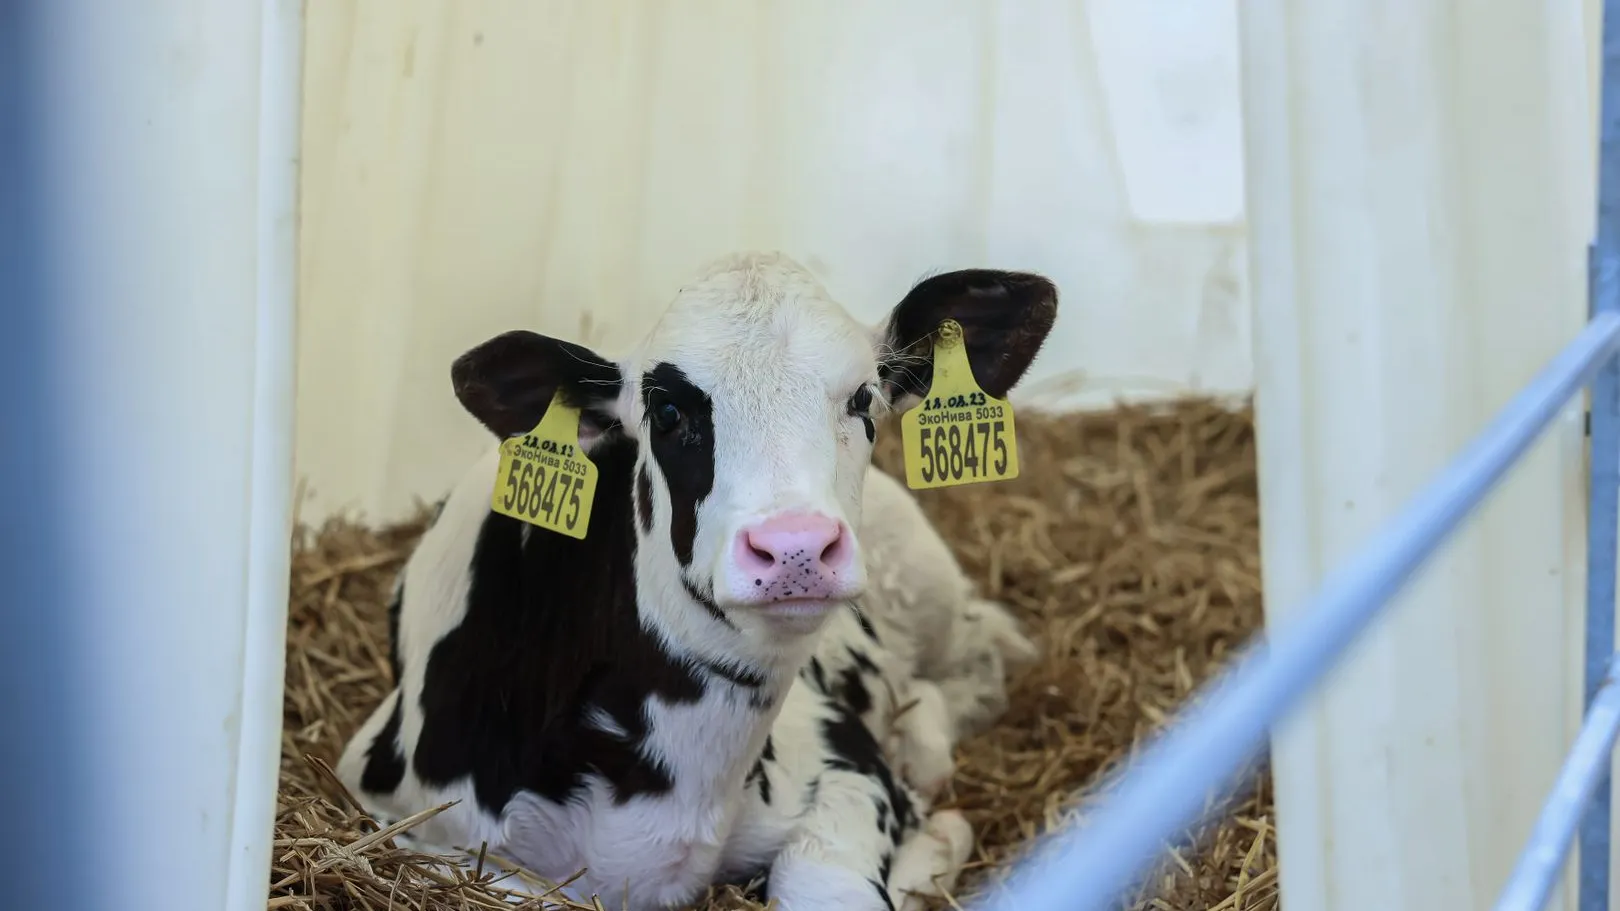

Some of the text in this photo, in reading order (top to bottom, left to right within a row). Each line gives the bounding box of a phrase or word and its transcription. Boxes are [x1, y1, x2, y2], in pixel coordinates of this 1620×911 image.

[918, 406, 1003, 426] ЭкоНива 5033
[513, 445, 587, 476] ЭкоНива 5033
[920, 421, 1007, 483] 568475
[504, 458, 584, 530] 568475
